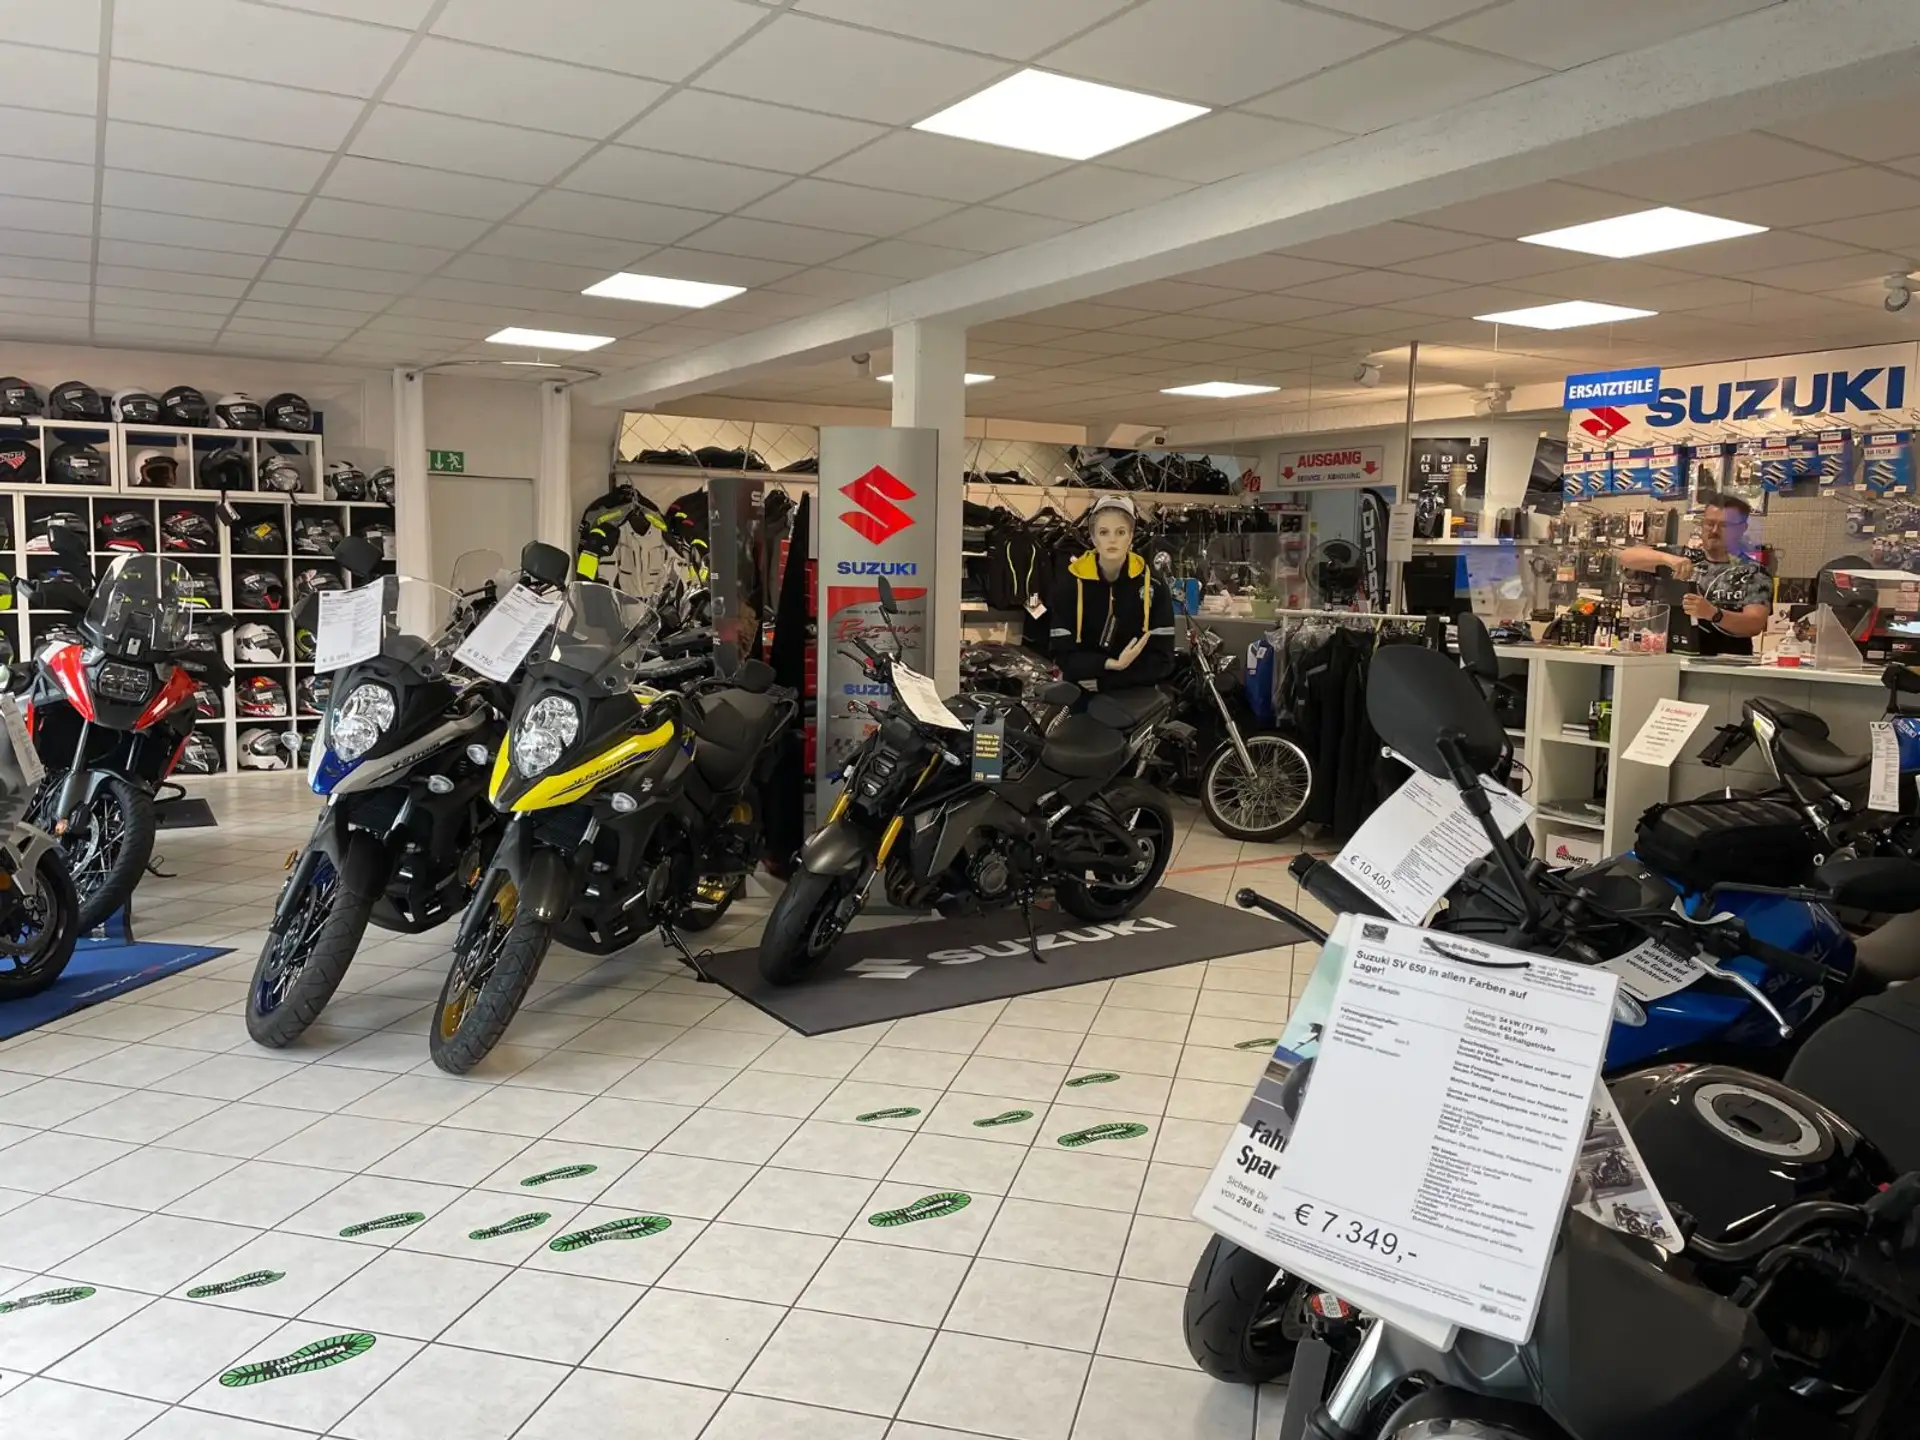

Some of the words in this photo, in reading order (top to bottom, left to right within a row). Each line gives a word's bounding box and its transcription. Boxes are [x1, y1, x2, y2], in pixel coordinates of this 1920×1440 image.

[1569, 377, 1654, 400] ERSATZTEILE
[1645, 365, 1906, 428] SUZUKI
[1297, 451, 1361, 468] AUSGANG
[836, 562, 916, 576] SUZUKI
[842, 683, 892, 697] SUZU
[1350, 855, 1360, 866] €
[1360, 861, 1396, 894] 10.400,-
[927, 916, 1177, 965] SUZUKI
[1353, 959, 1386, 976] Lager!
[1355, 950, 1391, 966] Suzuki
[1391, 958, 1408, 969] SV
[1408, 962, 1427, 974] 650
[1428, 967, 1439, 977] in
[1440, 971, 1467, 984] allen
[1468, 976, 1507, 995] Farben
[1508, 989, 1528, 1000] auf
[1226, 1174, 1256, 1197] Sichere
[1220, 1187, 1237, 1200] von
[1236, 1195, 1253, 1209] 250
[1294, 1203, 1314, 1227] €
[1321, 1210, 1417, 1264] 7.349,-
